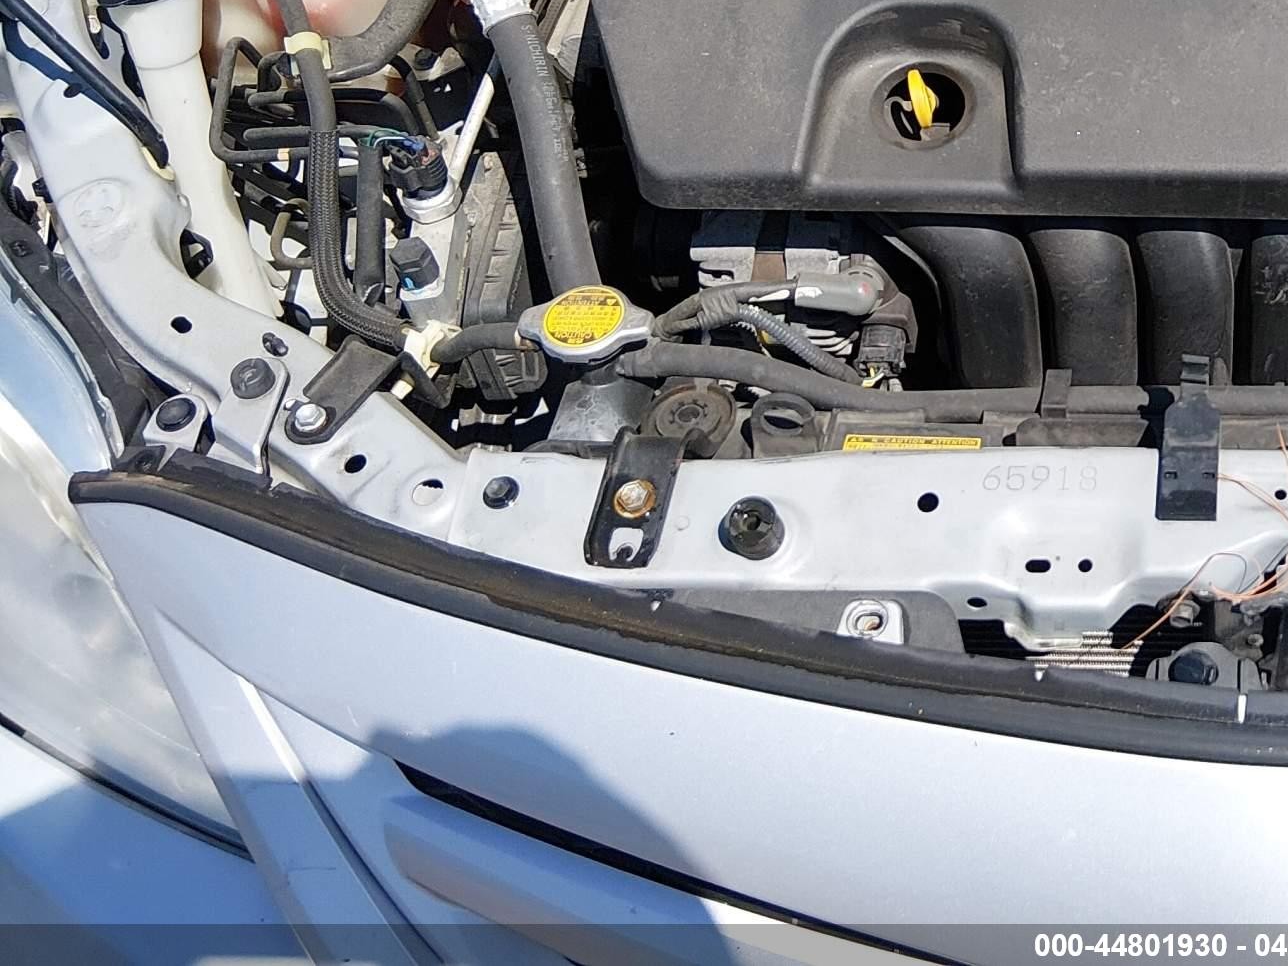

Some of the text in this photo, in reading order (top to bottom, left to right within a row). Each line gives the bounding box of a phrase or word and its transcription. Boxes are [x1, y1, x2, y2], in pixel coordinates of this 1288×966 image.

[554, 331, 592, 339] CAUTION
[884, 437, 925, 445] CAUTION
[982, 465, 1098, 491] 65918
